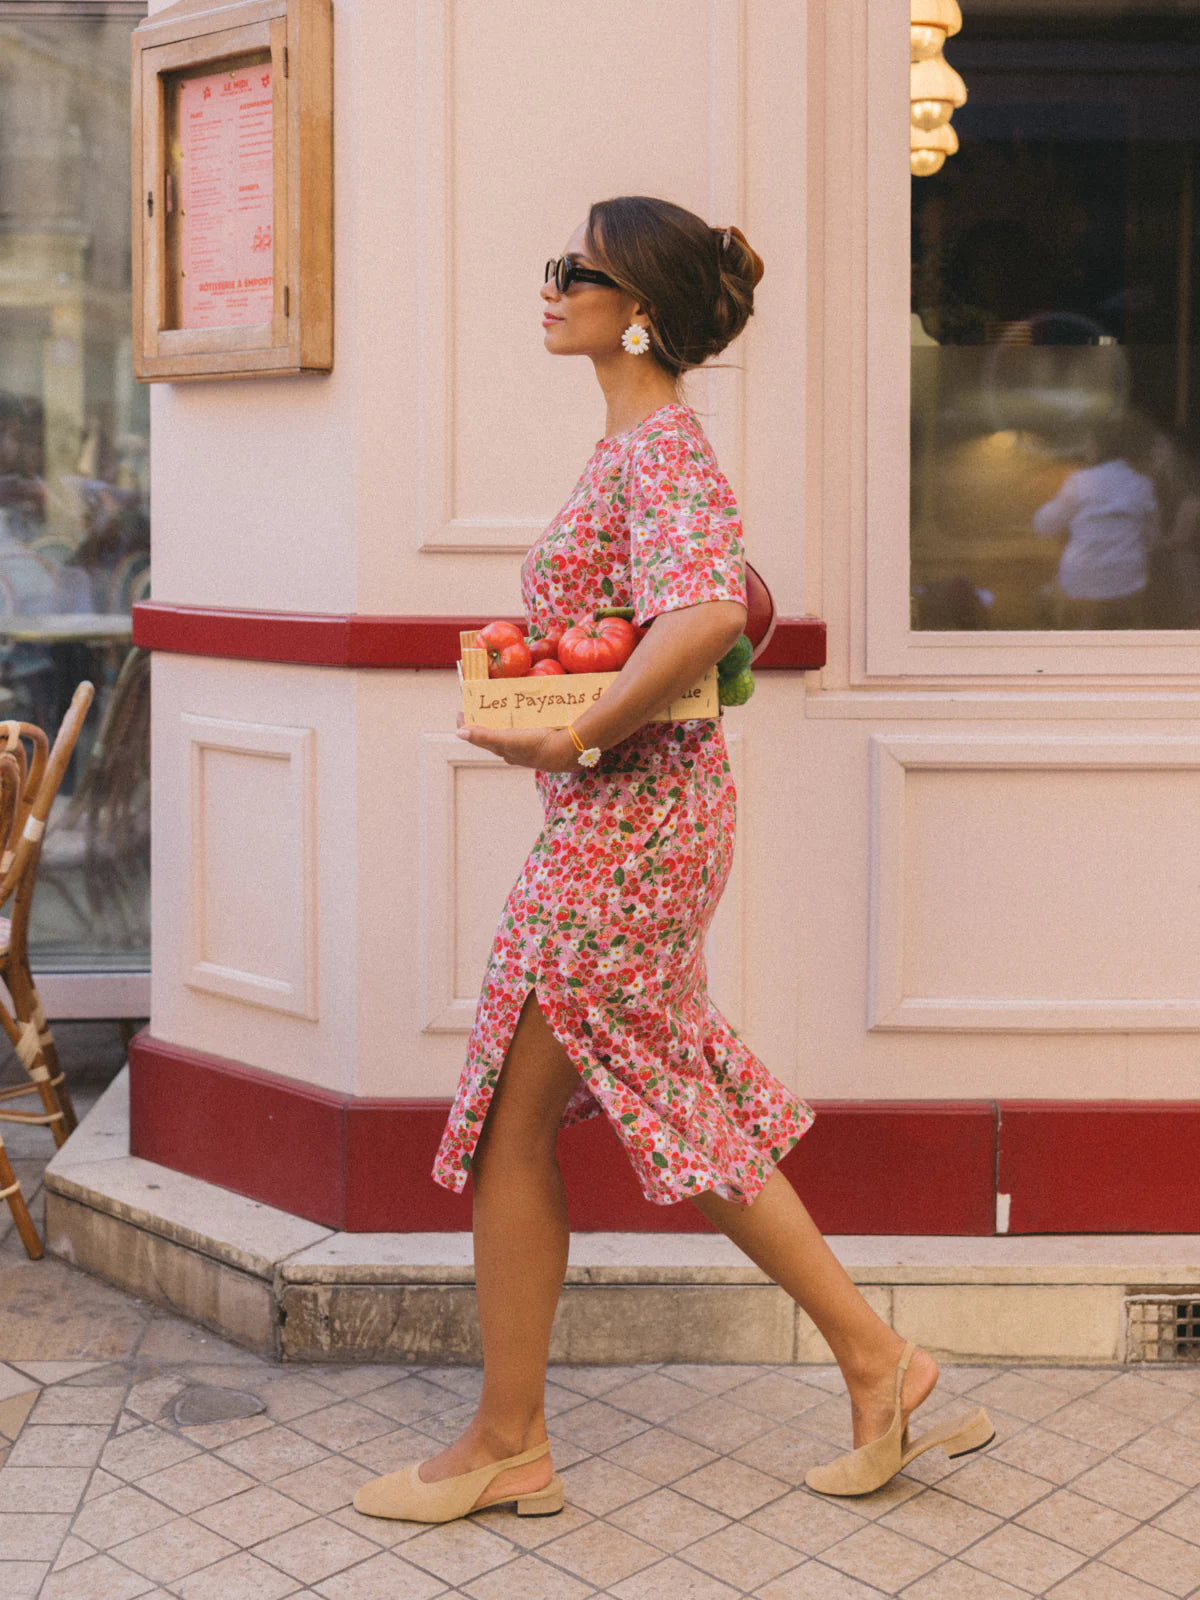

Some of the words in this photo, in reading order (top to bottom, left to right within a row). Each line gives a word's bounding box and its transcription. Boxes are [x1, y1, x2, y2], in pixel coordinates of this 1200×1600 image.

[244, 277, 273, 288] EMPORT
[479, 695, 507, 709] Les
[514, 692, 586, 713] Paysans
